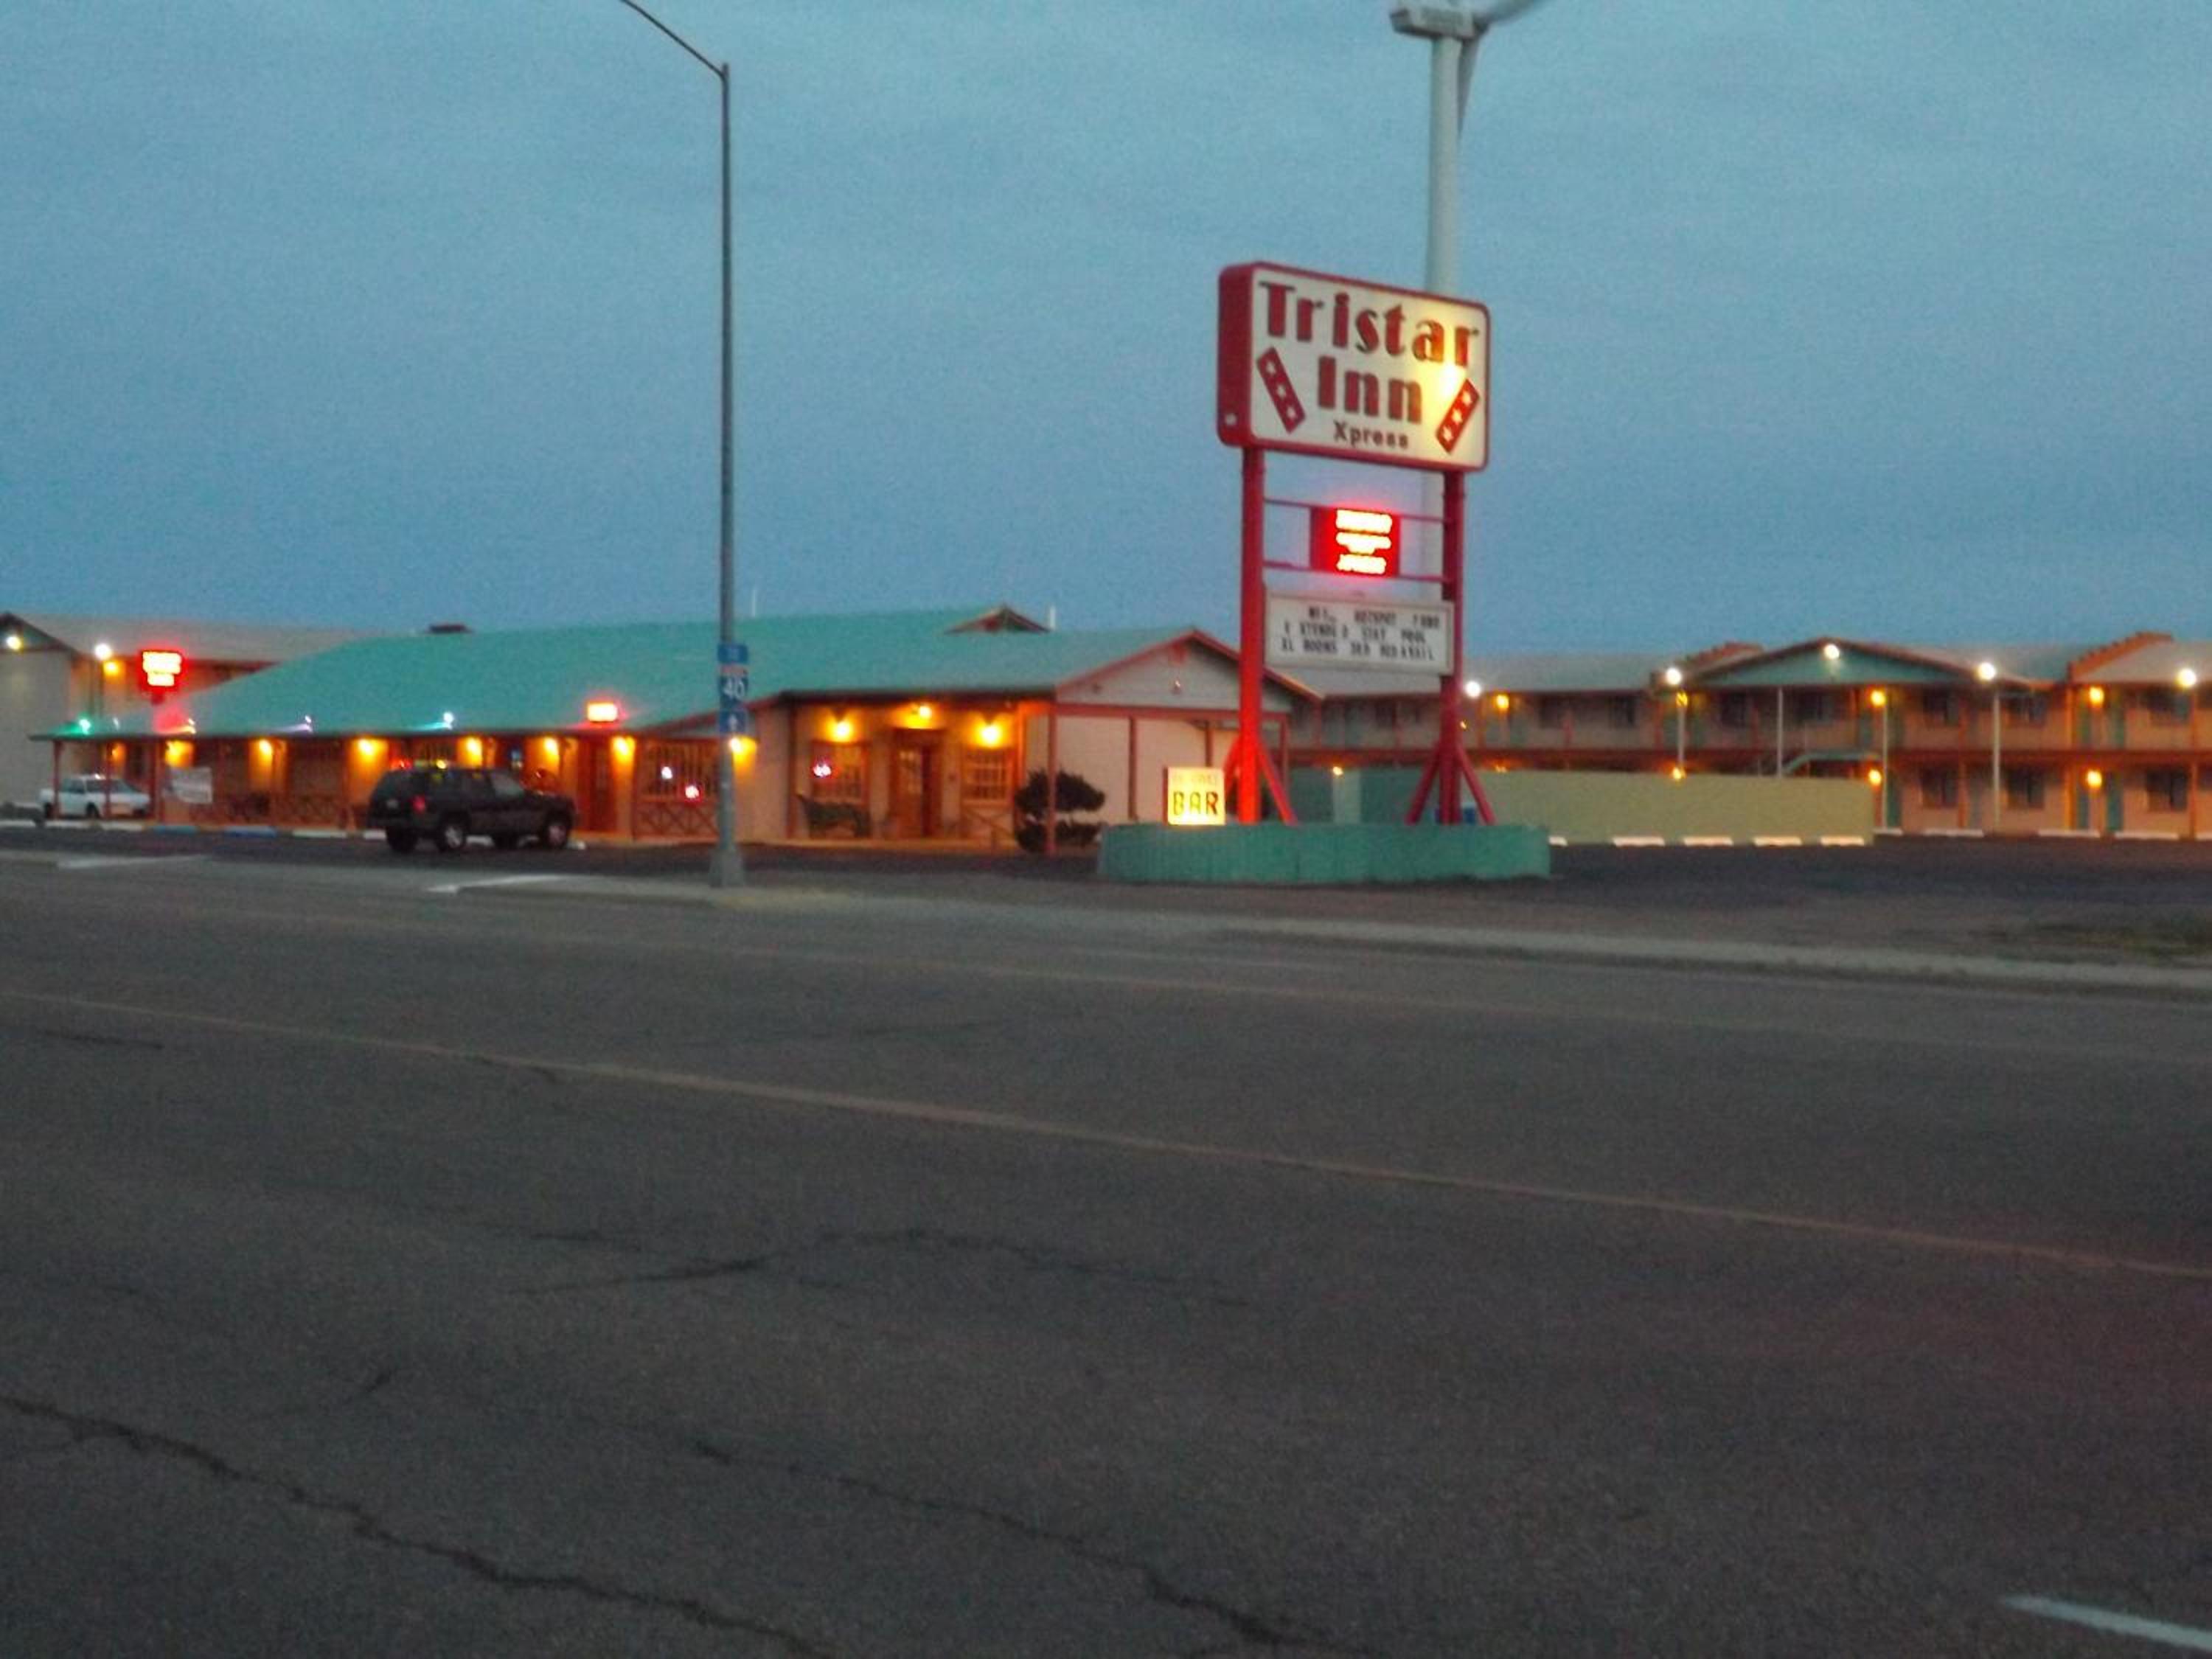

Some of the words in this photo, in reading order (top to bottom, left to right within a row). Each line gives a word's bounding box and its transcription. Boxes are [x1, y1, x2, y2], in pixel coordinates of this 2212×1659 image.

[1258, 280, 1479, 369] Tristar
[1317, 355, 1423, 425] Inn
[1332, 420, 1408, 449] Xpress
[1172, 790, 1219, 816] BAR
